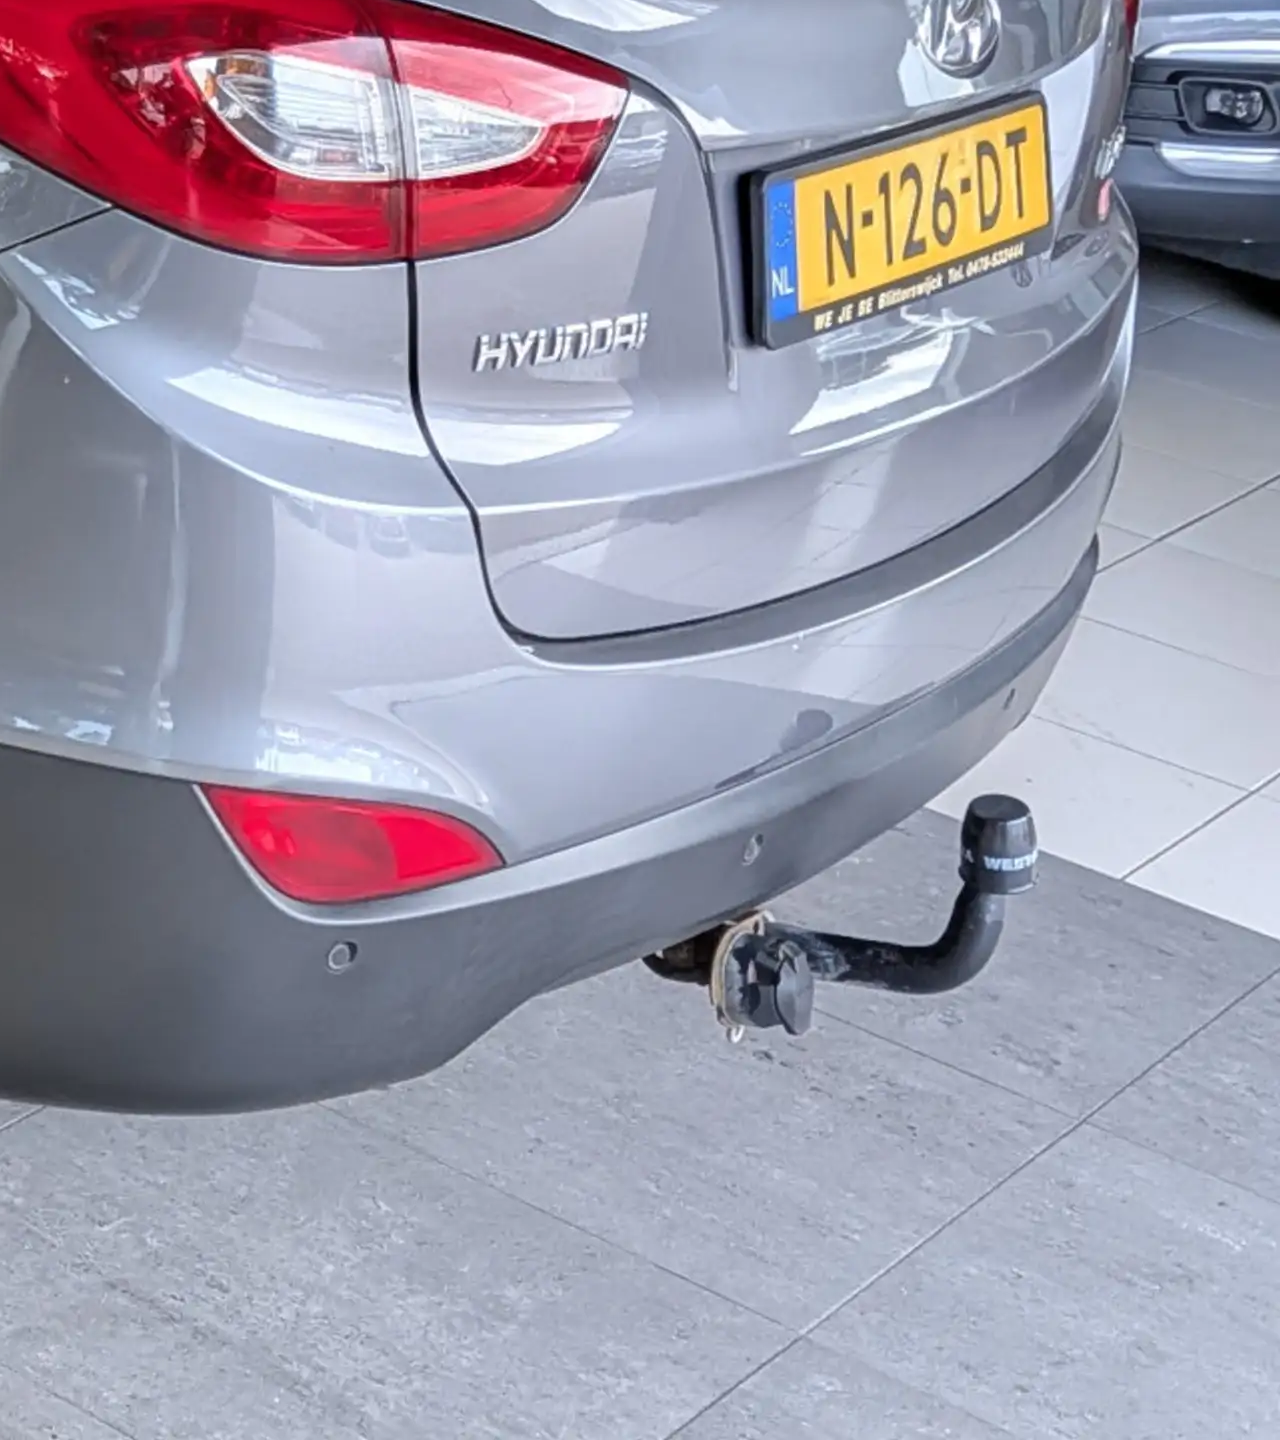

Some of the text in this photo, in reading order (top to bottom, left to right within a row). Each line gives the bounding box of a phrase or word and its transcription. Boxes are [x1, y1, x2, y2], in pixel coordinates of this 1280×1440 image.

[823, 125, 1028, 288] N-126-DT
[771, 266, 795, 299] NL
[472, 312, 649, 373] HYUNDAI
